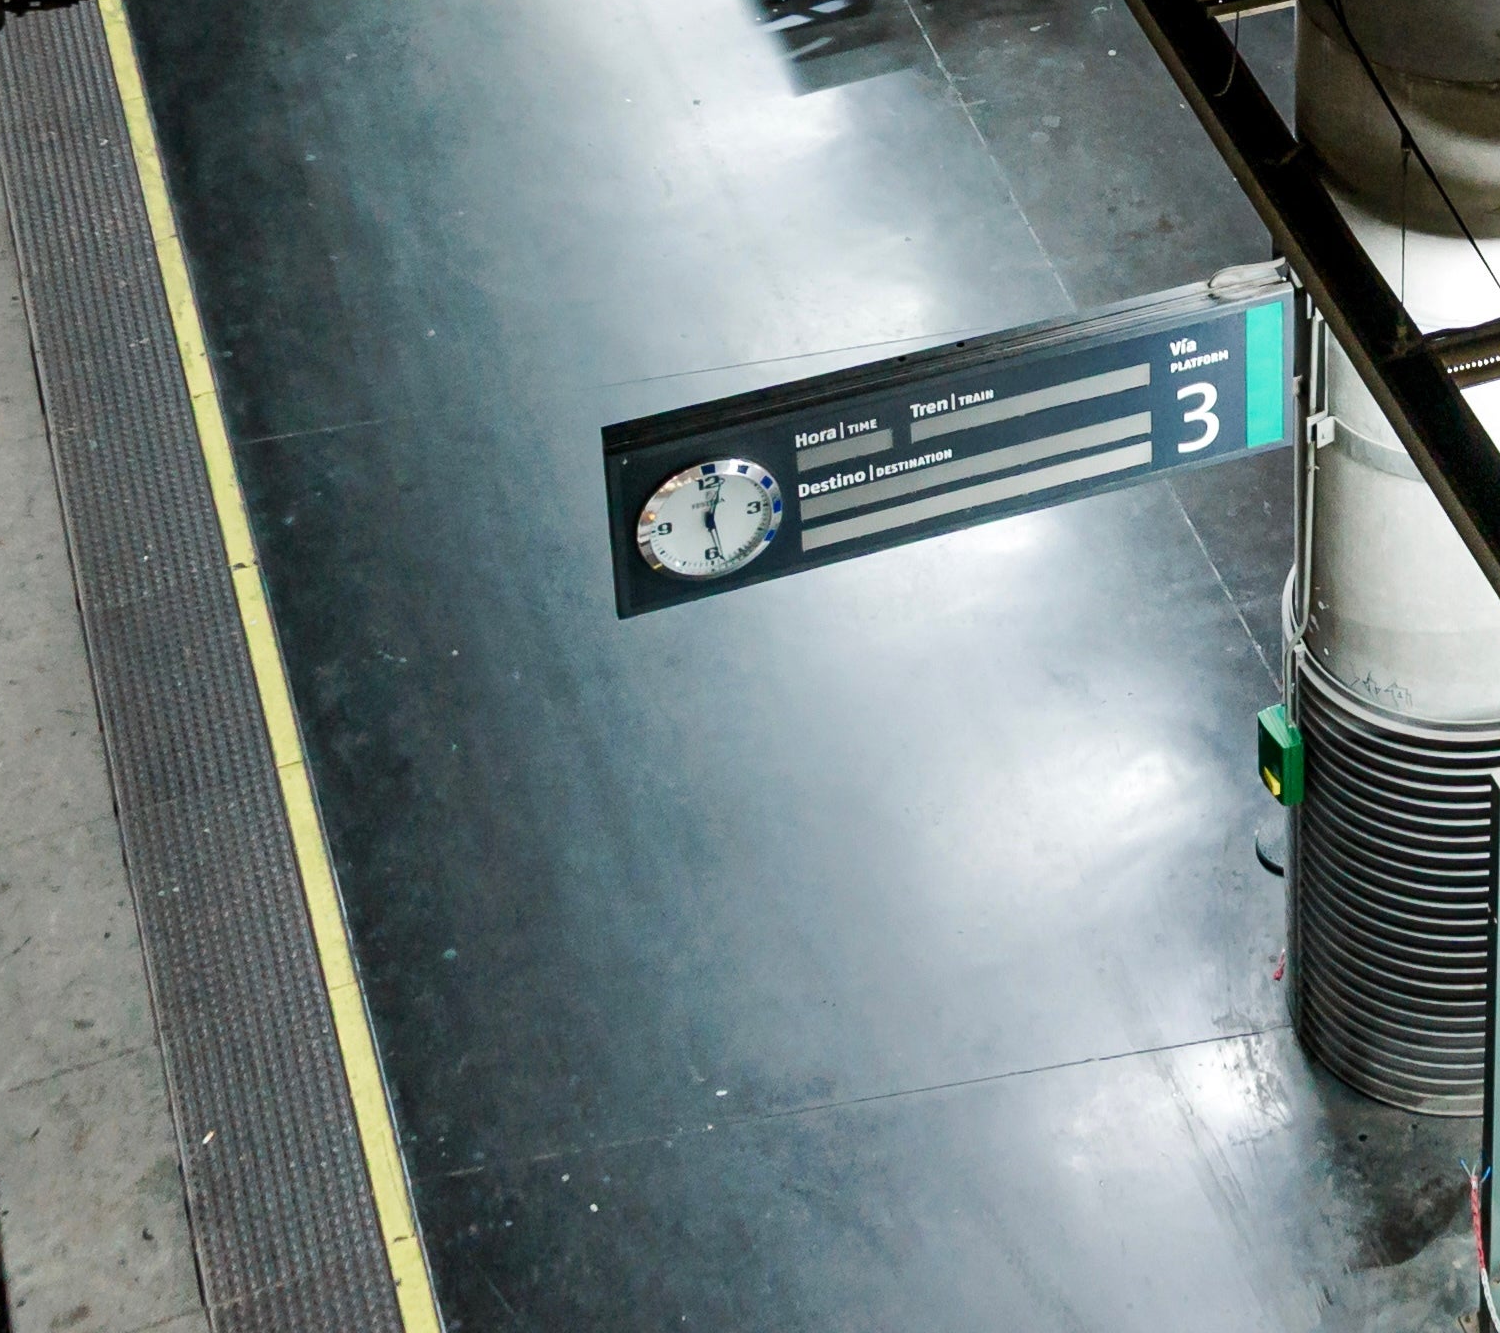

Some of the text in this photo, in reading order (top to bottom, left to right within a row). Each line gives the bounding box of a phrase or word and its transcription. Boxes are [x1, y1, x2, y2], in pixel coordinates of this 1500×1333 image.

[1169, 337, 1198, 357] Vía
[1170, 349, 1229, 373] PLATFORM
[910, 389, 995, 419] Tren TRAIN
[1176, 381, 1221, 454] 3
[795, 418, 878, 448] Hora TIME
[798, 448, 954, 499] Destino DESTINATION
[747, 501, 761, 514] 3
